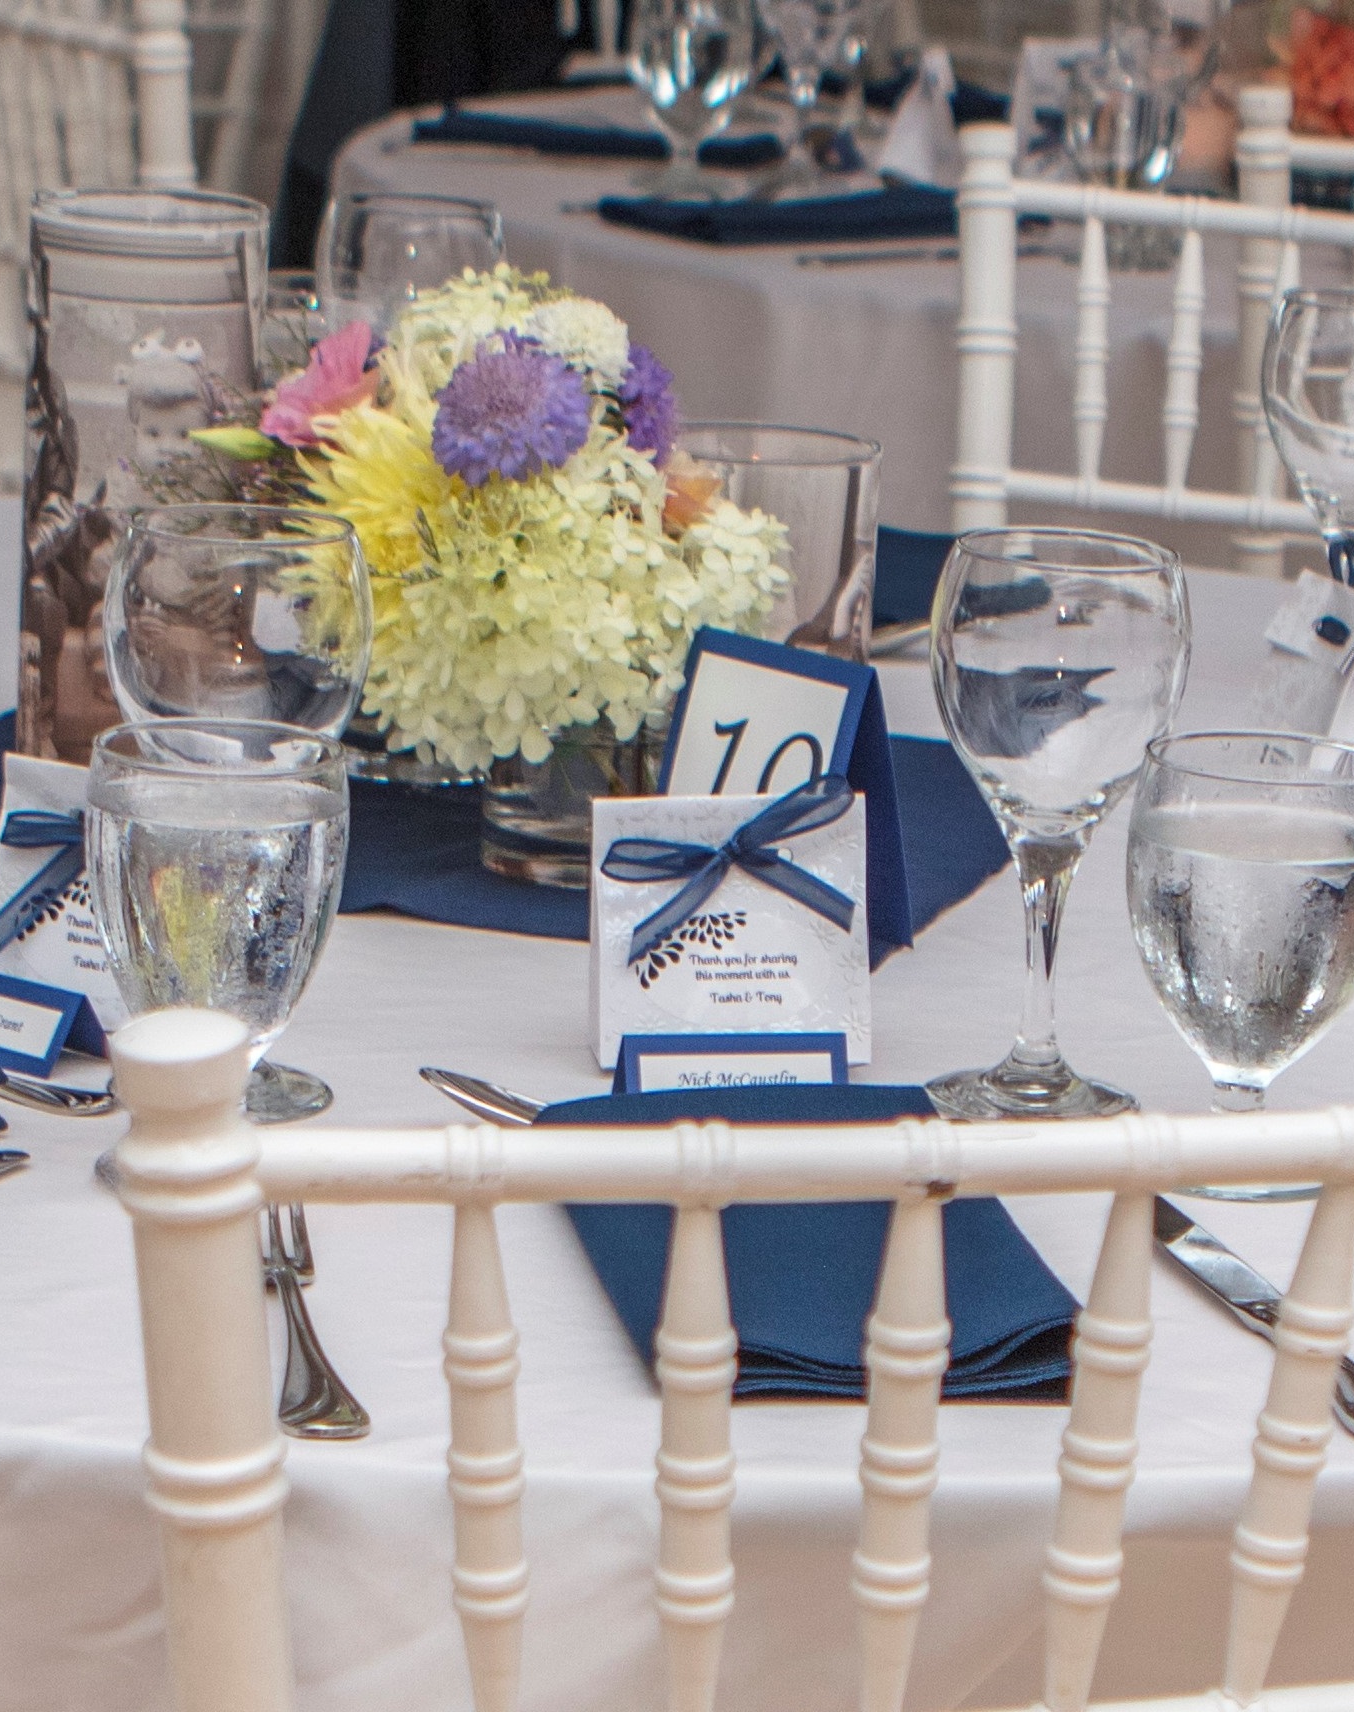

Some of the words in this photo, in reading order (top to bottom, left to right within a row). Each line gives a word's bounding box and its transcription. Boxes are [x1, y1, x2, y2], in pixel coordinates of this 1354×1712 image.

[710, 717, 823, 796] 10
[689, 953, 723, 966] Thank
[725, 956, 743, 967] you
[744, 953, 758, 967] for
[760, 953, 798, 967] sharing
[695, 969, 714, 981] this
[715, 969, 754, 980] moment
[755, 969, 776, 980] with
[710, 991, 743, 1004] Tasha
[745, 990, 753, 1004] &
[755, 990, 783, 1005] Tony
[678, 1070, 713, 1088] Nick
